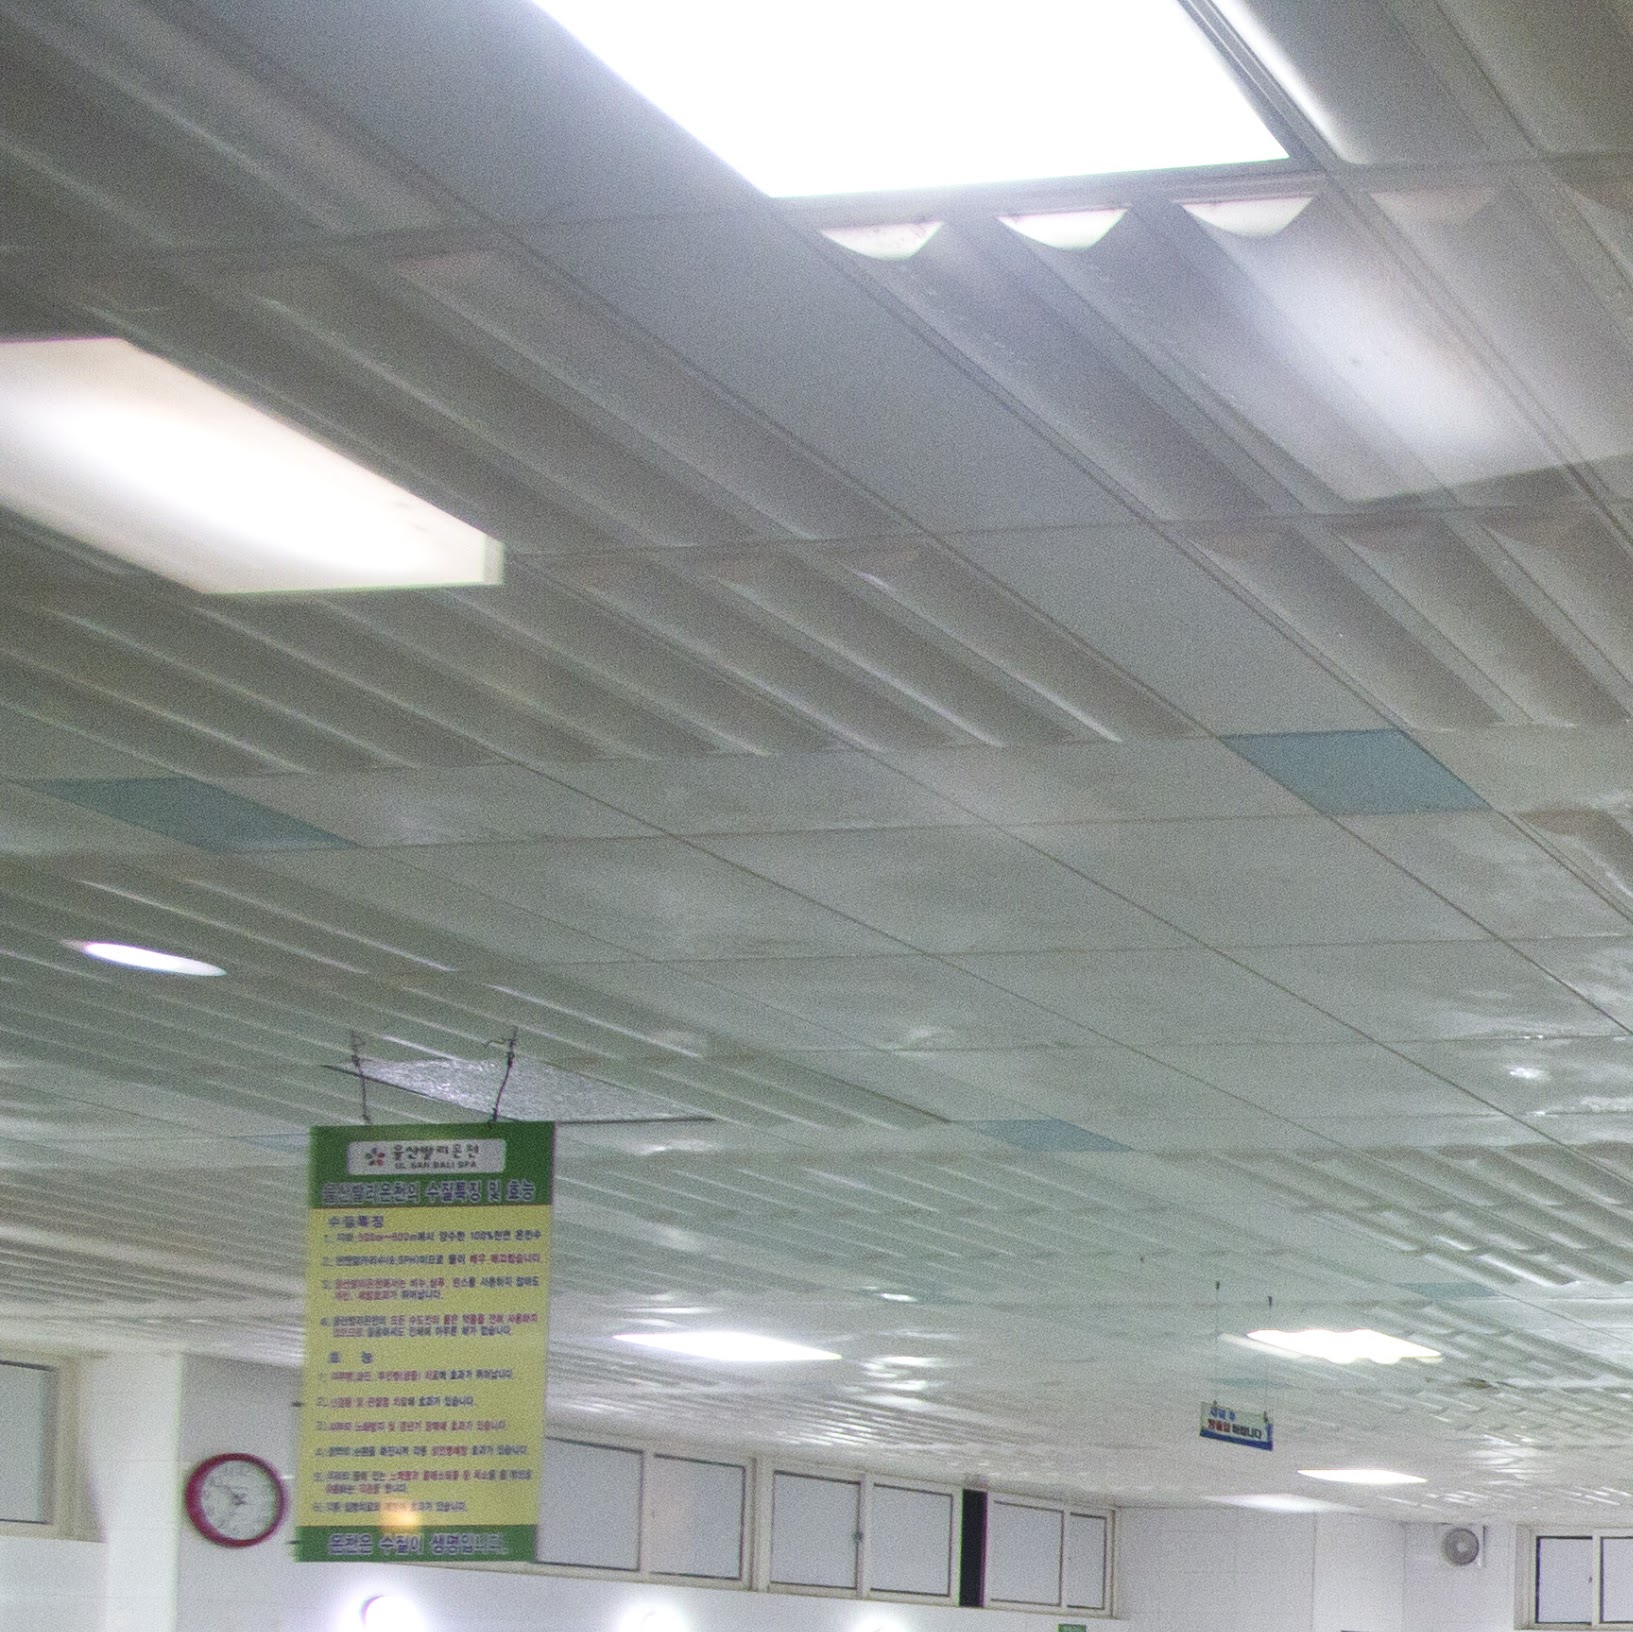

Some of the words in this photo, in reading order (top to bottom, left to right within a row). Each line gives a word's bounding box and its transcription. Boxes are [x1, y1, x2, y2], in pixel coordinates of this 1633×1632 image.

[426, 1181, 481, 1202] 수질특징
[506, 1179, 535, 1201] 효능
[329, 1533, 372, 1555] 온천은
[379, 1533, 423, 1554] 수질이
